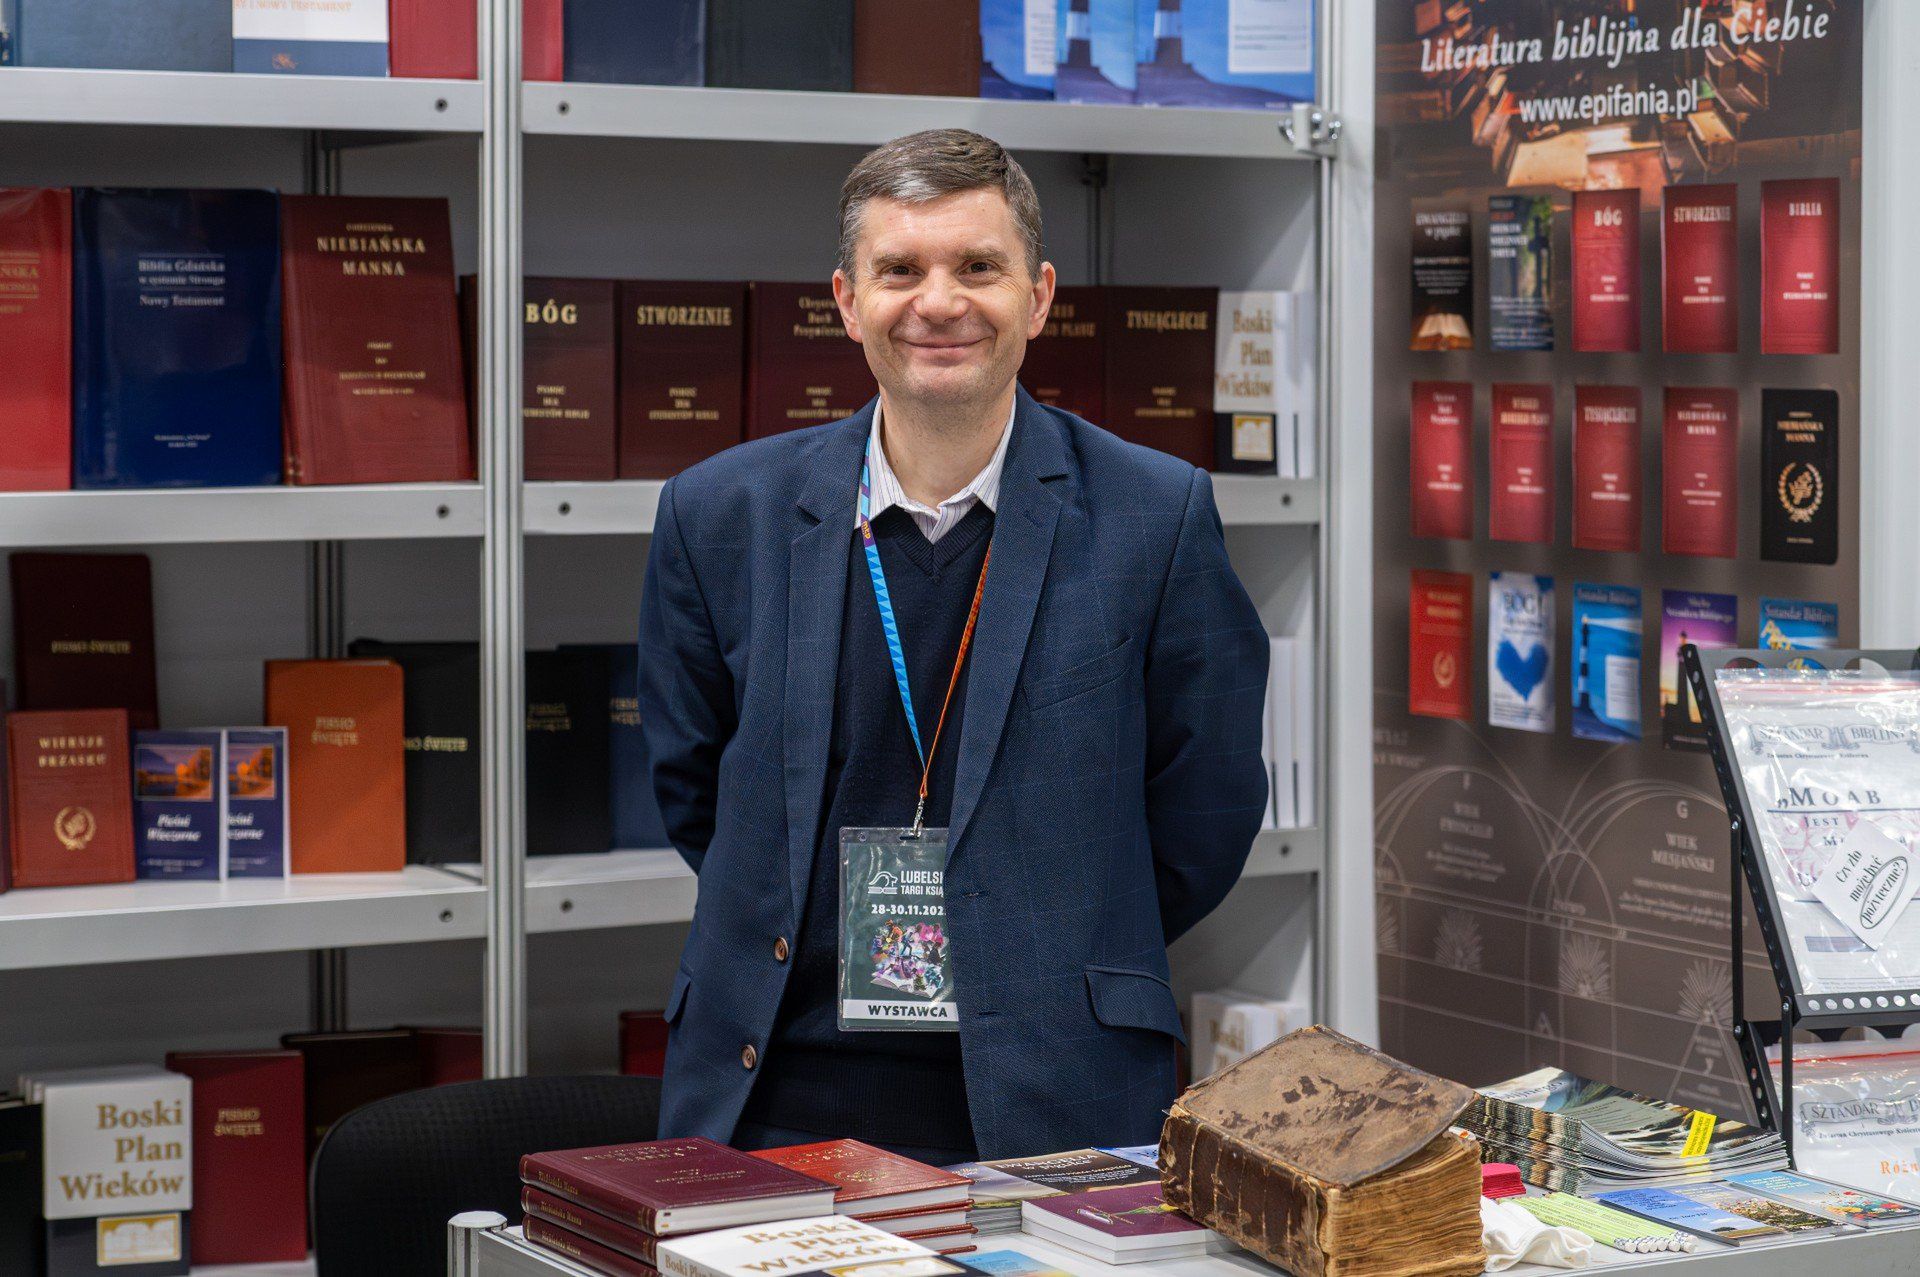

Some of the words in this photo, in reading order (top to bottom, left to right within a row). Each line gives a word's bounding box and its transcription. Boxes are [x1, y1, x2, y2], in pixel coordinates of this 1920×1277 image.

[1421, 38, 1543, 73] Literatura
[1552, 18, 1660, 69] biblijna
[1671, 7, 1718, 51] dla
[1730, 4, 1830, 46] Ciebie
[1519, 79, 1699, 124] www.epifania.pl
[1594, 205, 1623, 226] BÓG
[317, 235, 427, 253] NIEBIAŃSKA
[343, 261, 405, 276] MANNA
[525, 299, 578, 324] BÓG
[637, 305, 733, 326] STWORZENIE
[1241, 341, 1273, 367] Plan
[901, 885, 923, 896] TARGI
[871, 904, 947, 916] 28-30.11.202
[868, 1005, 948, 1018] WYSTAWCA
[96, 1099, 184, 1131] Boski
[1811, 1101, 1881, 1120] SZTANDAR
[114, 1134, 183, 1164] Plan
[59, 1170, 184, 1201] Wieków
[740, 1221, 866, 1245] Boski
[790, 1234, 887, 1250] Plan
